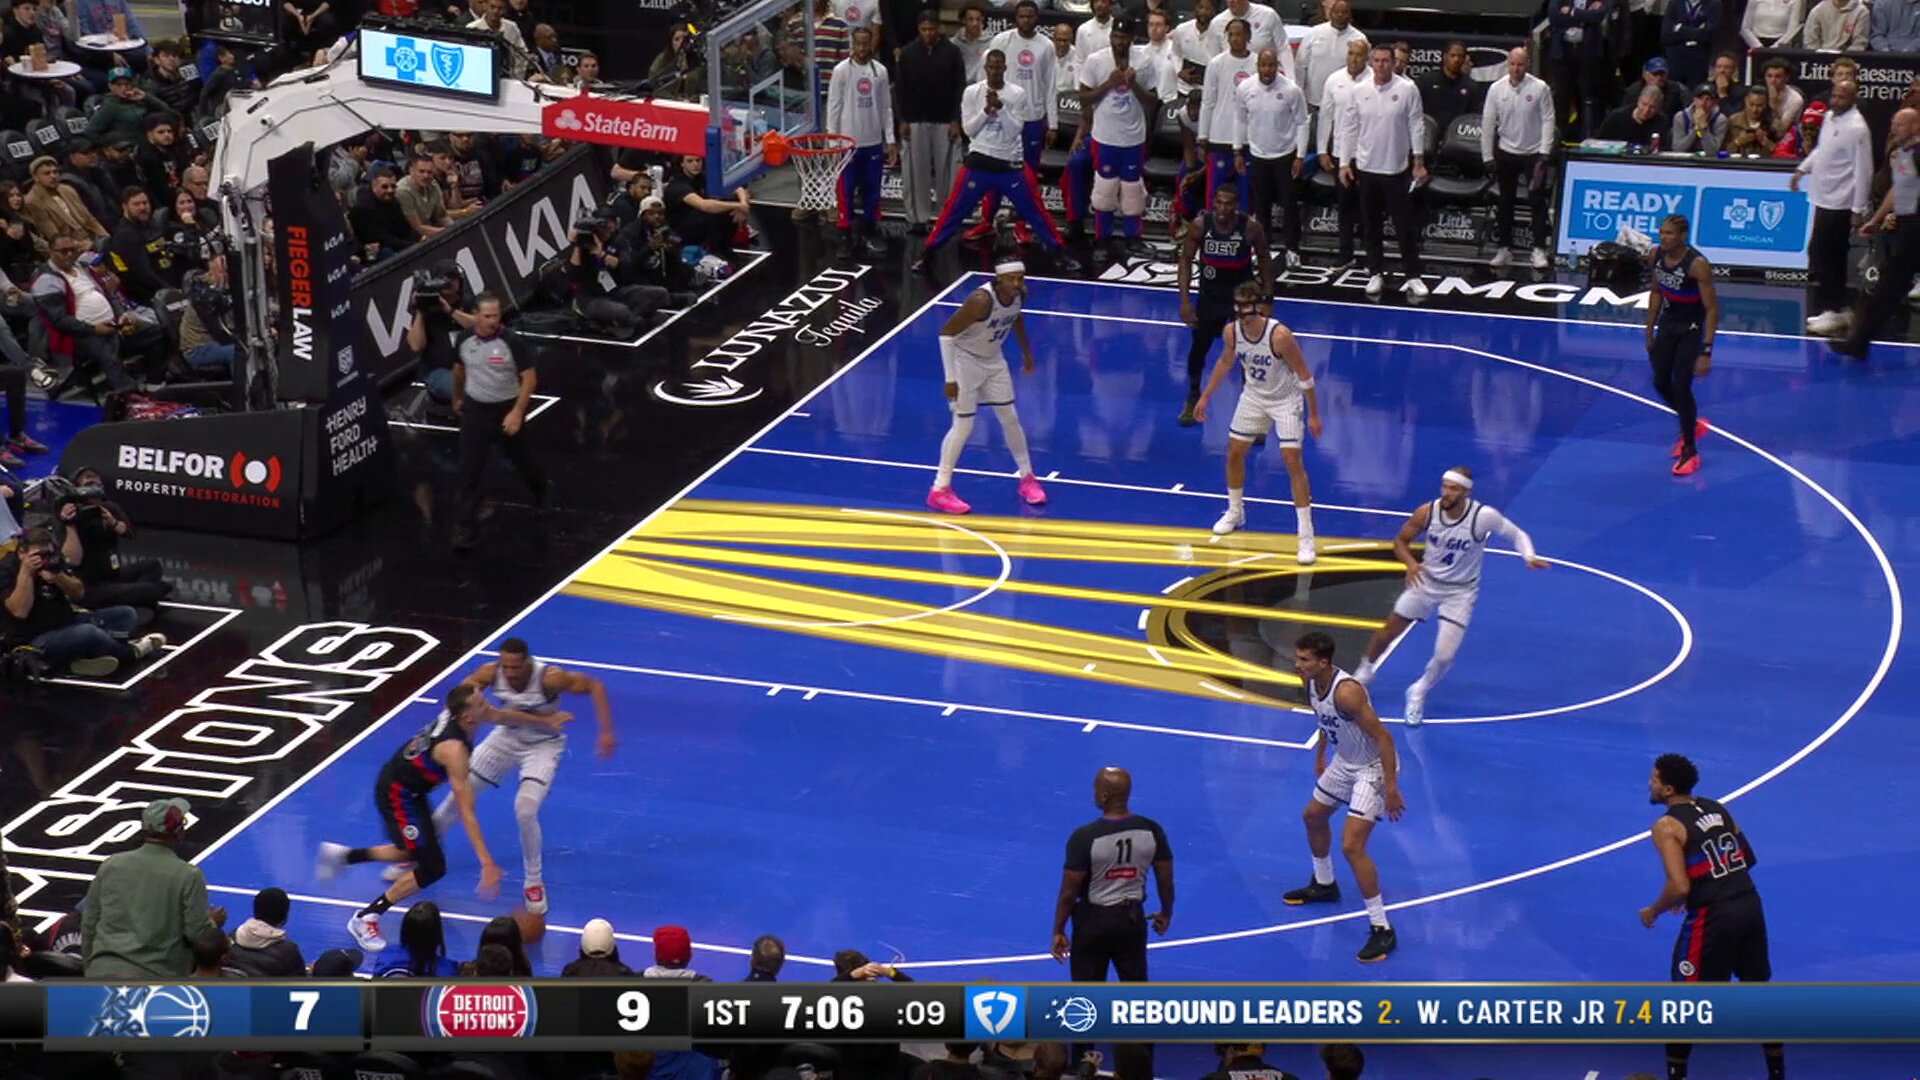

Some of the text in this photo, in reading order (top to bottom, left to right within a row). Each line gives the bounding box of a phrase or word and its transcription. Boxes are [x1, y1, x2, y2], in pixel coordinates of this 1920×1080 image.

[1800, 62, 1914, 84] Litt aesars
[1583, 189, 1682, 214] READY
[1438, 212, 1472, 228] Little
[1583, 212, 1660, 234] TO HEL
[1205, 239, 1240, 257] DET
[1728, 234, 1775, 244] MICHIGAN
[1276, 264, 1651, 309] BEMGM
[1764, 269, 1809, 281] StockX
[691, 264, 873, 371] LUNAZUL
[795, 296, 883, 347] Tequila
[1250, 366, 1266, 381] 22
[325, 396, 367, 434] HENRY
[330, 424, 360, 455] FORD
[117, 444, 224, 479] BELFOR
[333, 435, 378, 476] HEALTH
[1440, 552, 1455, 565] 4
[0, 621, 441, 934] ISTONS
[1115, 838, 1131, 864] 11
[1701, 832, 1747, 878] 12
